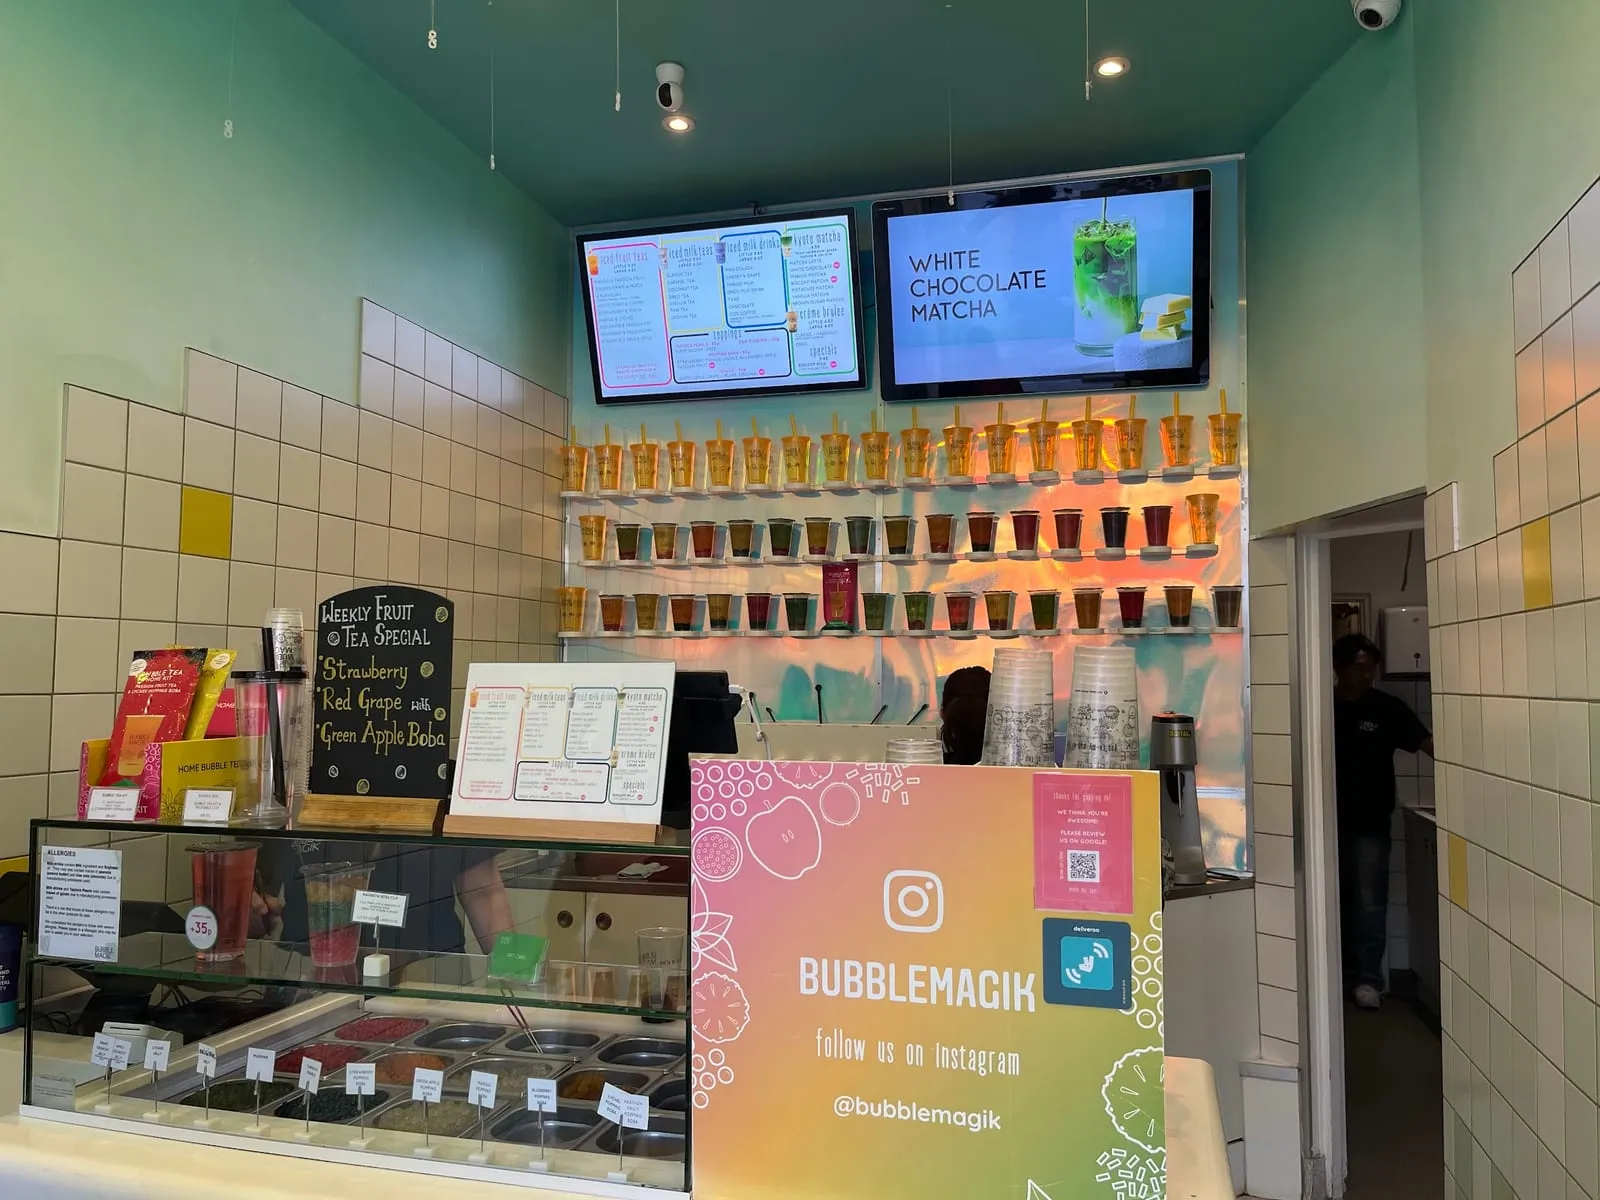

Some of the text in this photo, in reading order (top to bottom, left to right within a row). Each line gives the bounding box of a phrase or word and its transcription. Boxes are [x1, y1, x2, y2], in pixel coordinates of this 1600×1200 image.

[794, 229, 840, 247] kyoto matcha
[908, 250, 980, 272] WHITE
[910, 270, 1047, 297] CHOCOLATE
[911, 300, 997, 322] MATCHA
[322, 595, 414, 623] WEEKLY FRUIT
[341, 622, 431, 647] TEA SPECIAL
[322, 655, 408, 690] Strawberry
[322, 687, 352, 710] Red
[358, 687, 402, 720] Grape
[320, 722, 356, 750] Green
[361, 720, 405, 756] Apple
[407, 722, 446, 747] Boba
[178, 764, 199, 773] HOME
[201, 762, 228, 771] BUBBLE
[191, 921, 212, 936] +35p
[800, 956, 1036, 1012] BUBBLEMAGIK
[816, 1028, 1020, 1076] follow us on instagram
[833, 1095, 1001, 1132] @bubblemagik
